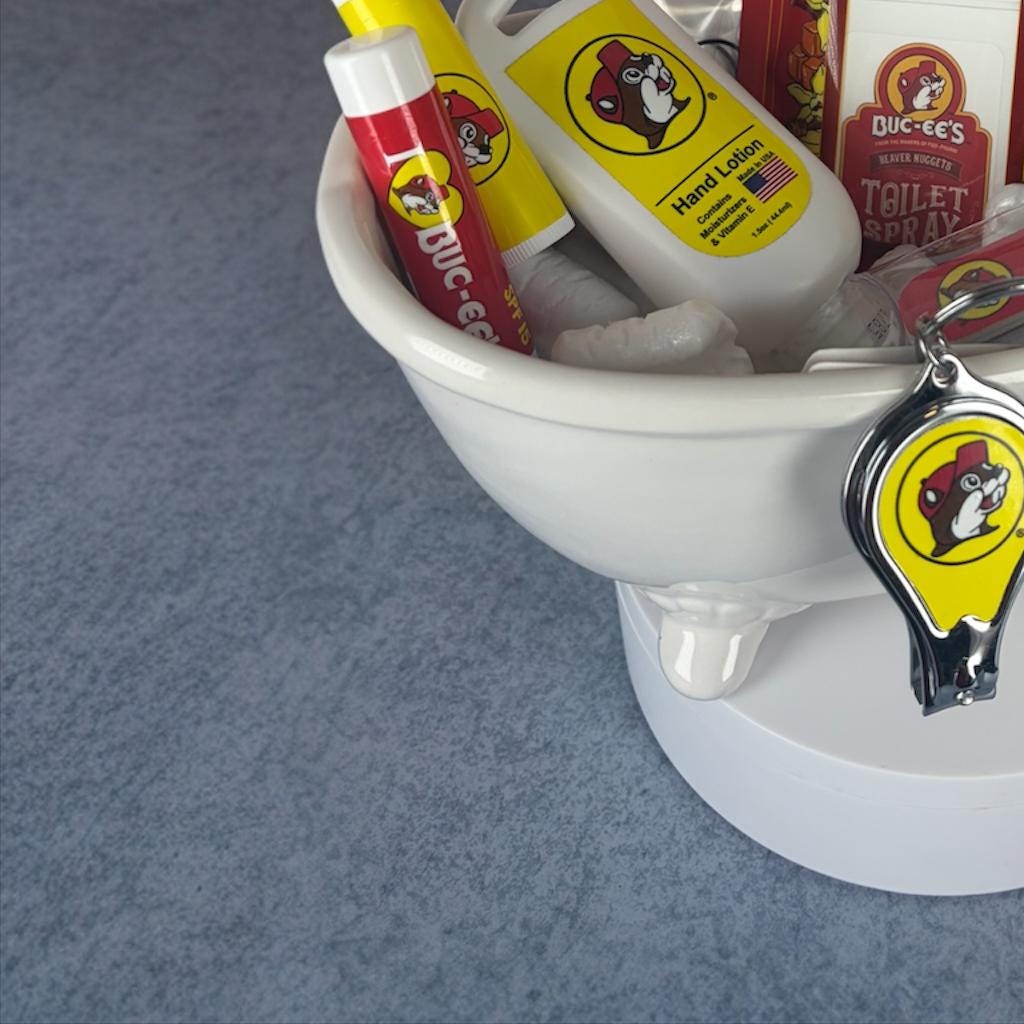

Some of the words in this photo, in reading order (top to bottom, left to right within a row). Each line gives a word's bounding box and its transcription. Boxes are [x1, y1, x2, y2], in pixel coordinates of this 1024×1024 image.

[872, 115, 965, 145] BUC-EE'S
[671, 173, 719, 216] Hand
[714, 139, 764, 178] Lotion
[878, 153, 912, 165] BEAVER
[913, 153, 953, 172] NUGGETS
[697, 193, 732, 225] Contains
[699, 197, 747, 239] Moisturizers
[861, 178, 969, 219] TOILET
[710, 238, 720, 246] &
[717, 212, 749, 239] Vitamin
[746, 205, 755, 214] E
[863, 210, 960, 247] SPRAY
[415, 219, 502, 344] BUC-EE'
[503, 284, 524, 321] SPF
